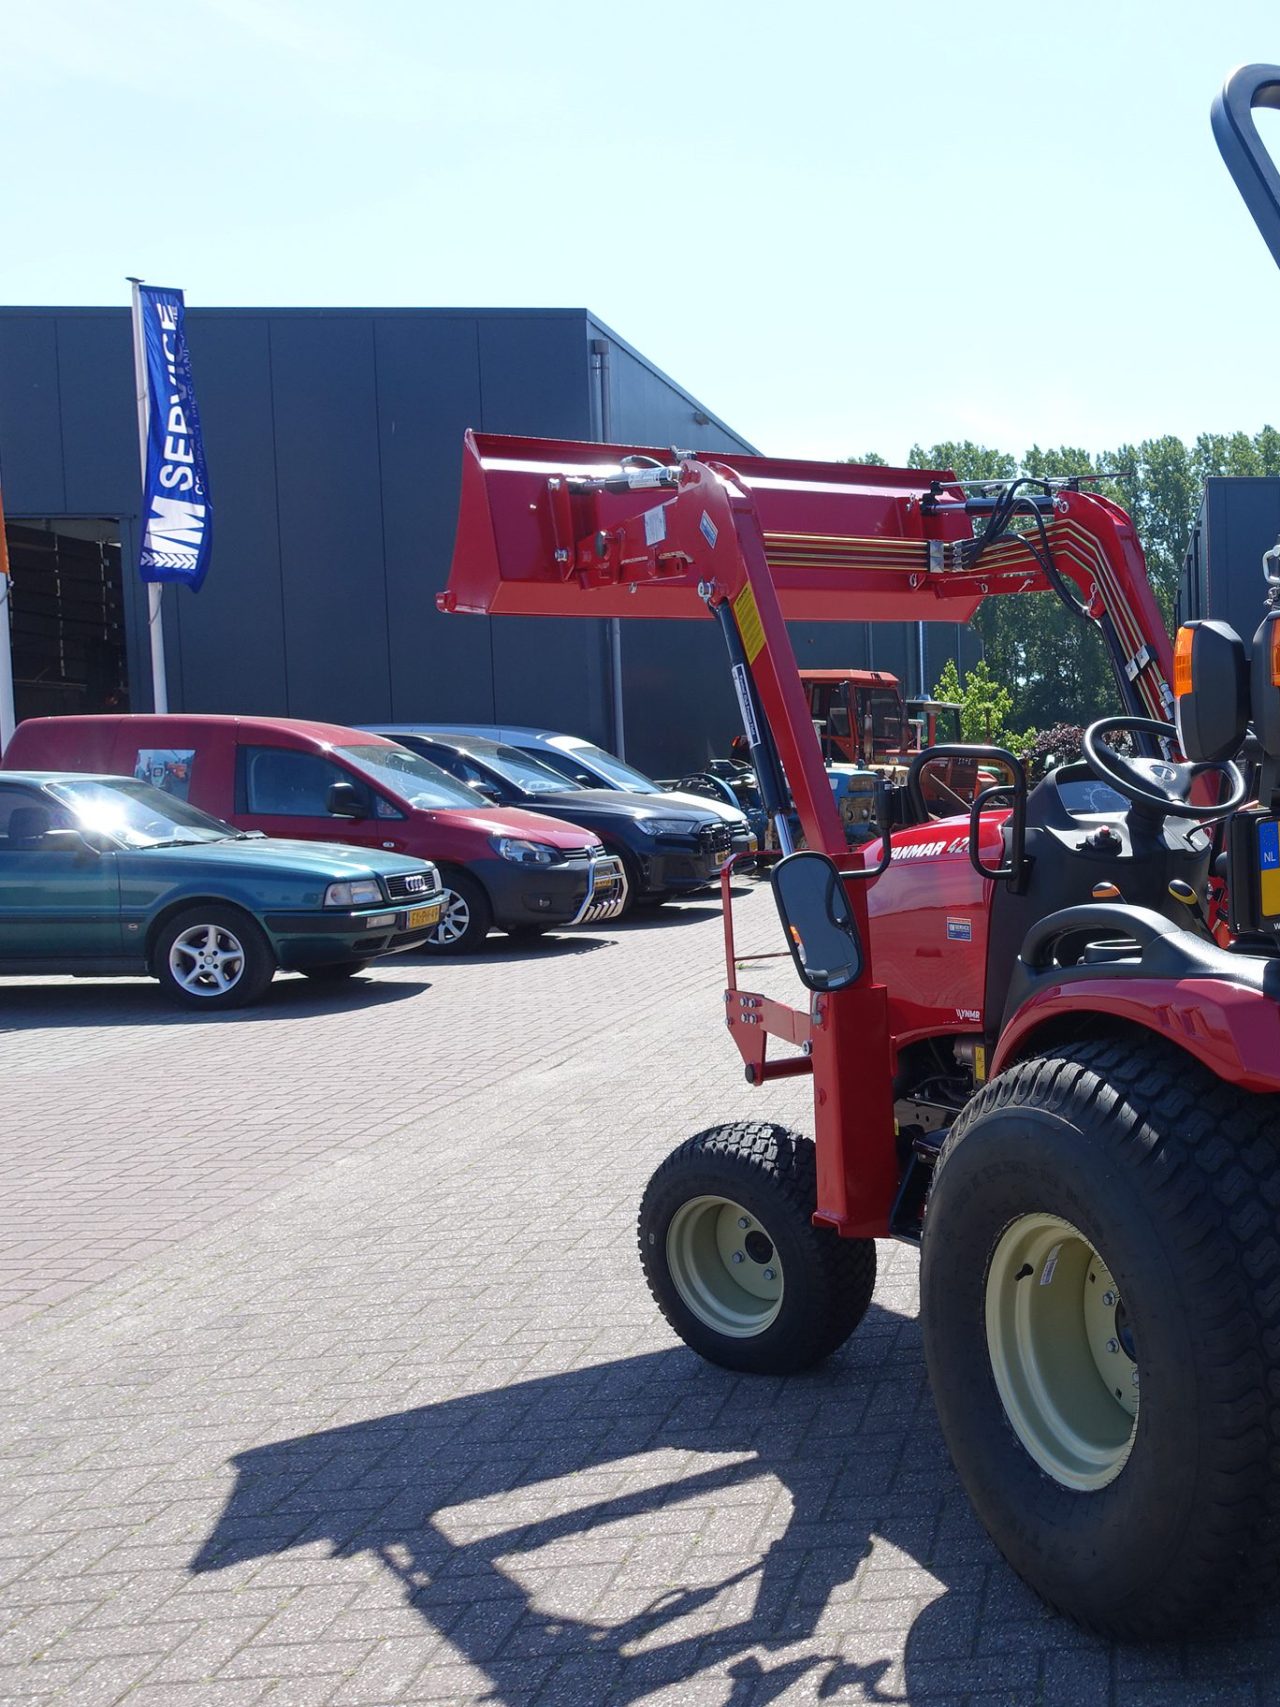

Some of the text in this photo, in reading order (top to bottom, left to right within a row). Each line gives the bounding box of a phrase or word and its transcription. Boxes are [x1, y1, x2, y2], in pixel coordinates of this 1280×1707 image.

[157, 303, 195, 491] SERVICE
[891, 841, 947, 860] ANMAR
[1264, 852, 1276, 863] NL
